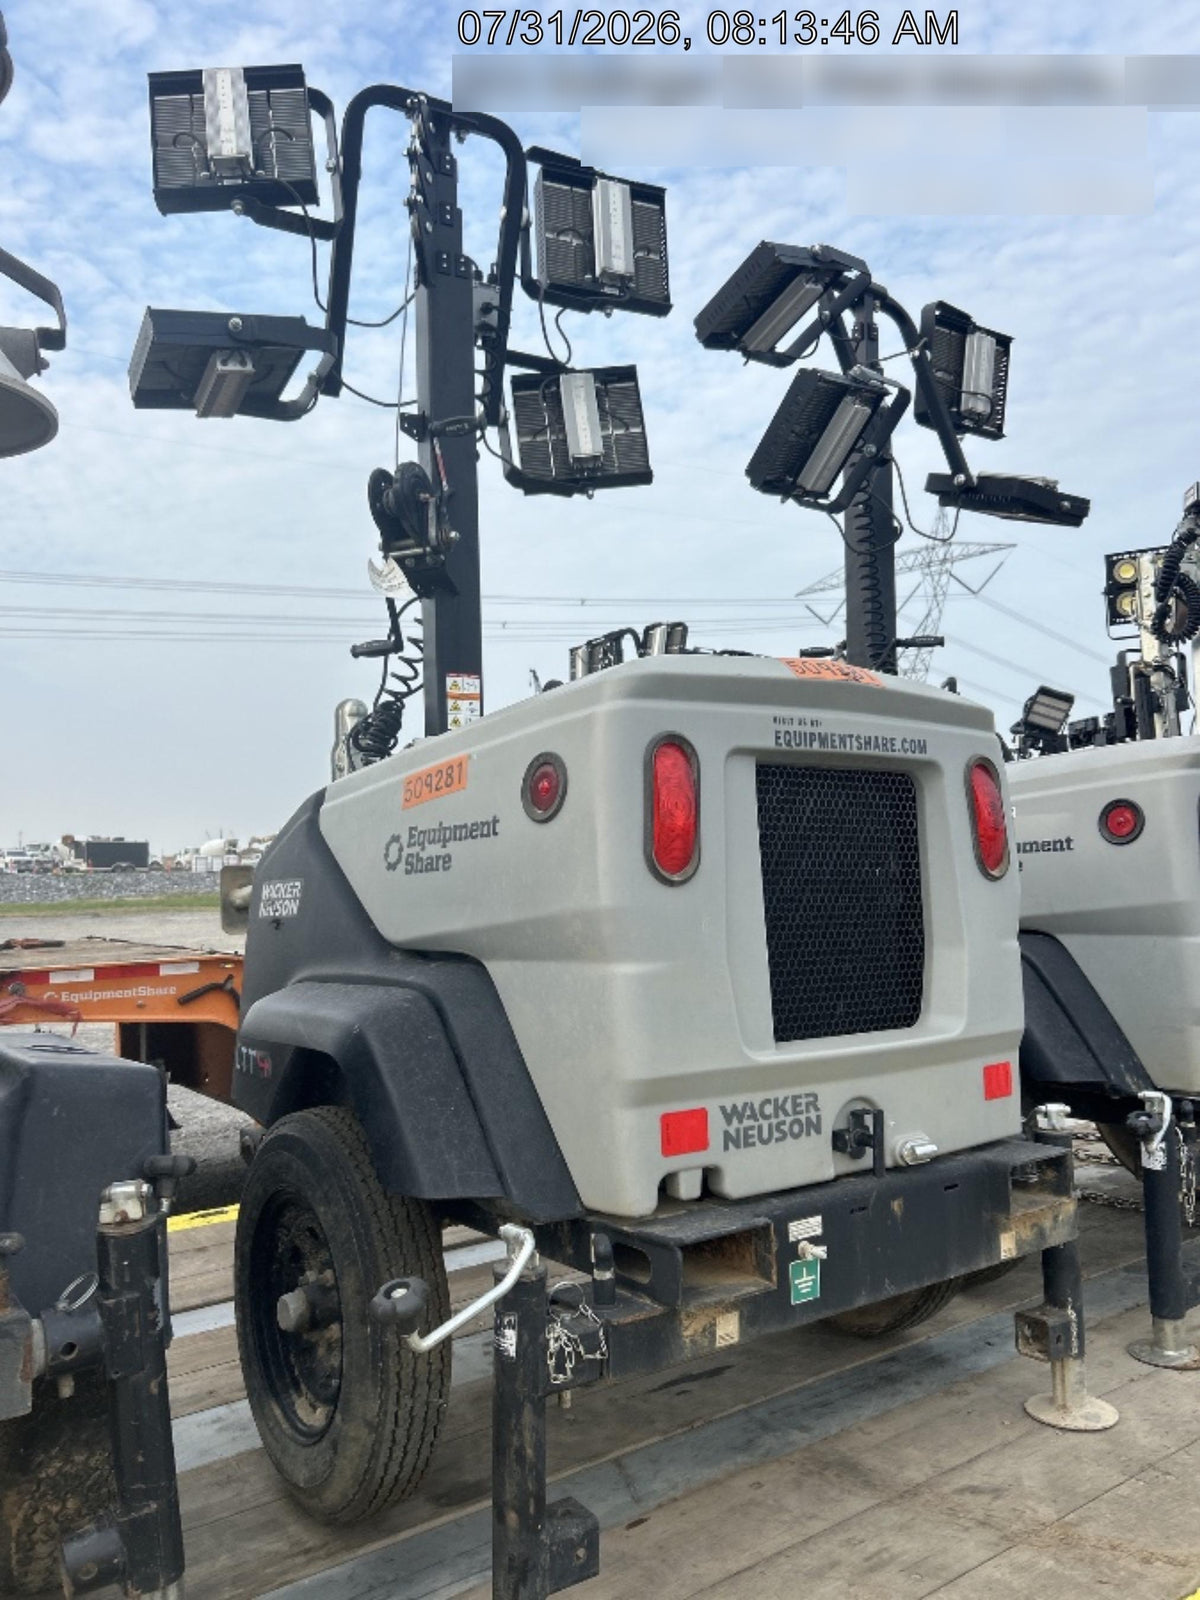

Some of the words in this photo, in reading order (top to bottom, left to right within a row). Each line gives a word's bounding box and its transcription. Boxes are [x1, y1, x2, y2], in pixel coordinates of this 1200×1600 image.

[775, 730, 928, 755] EQUIPMENTSHARE.COM
[404, 761, 463, 802] 509281
[407, 815, 500, 851] Equipment
[405, 852, 452, 875] Share
[61, 985, 177, 1003] EquipmentShare
[719, 1093, 821, 1127] WACKER
[723, 1114, 823, 1153] NEUSON
